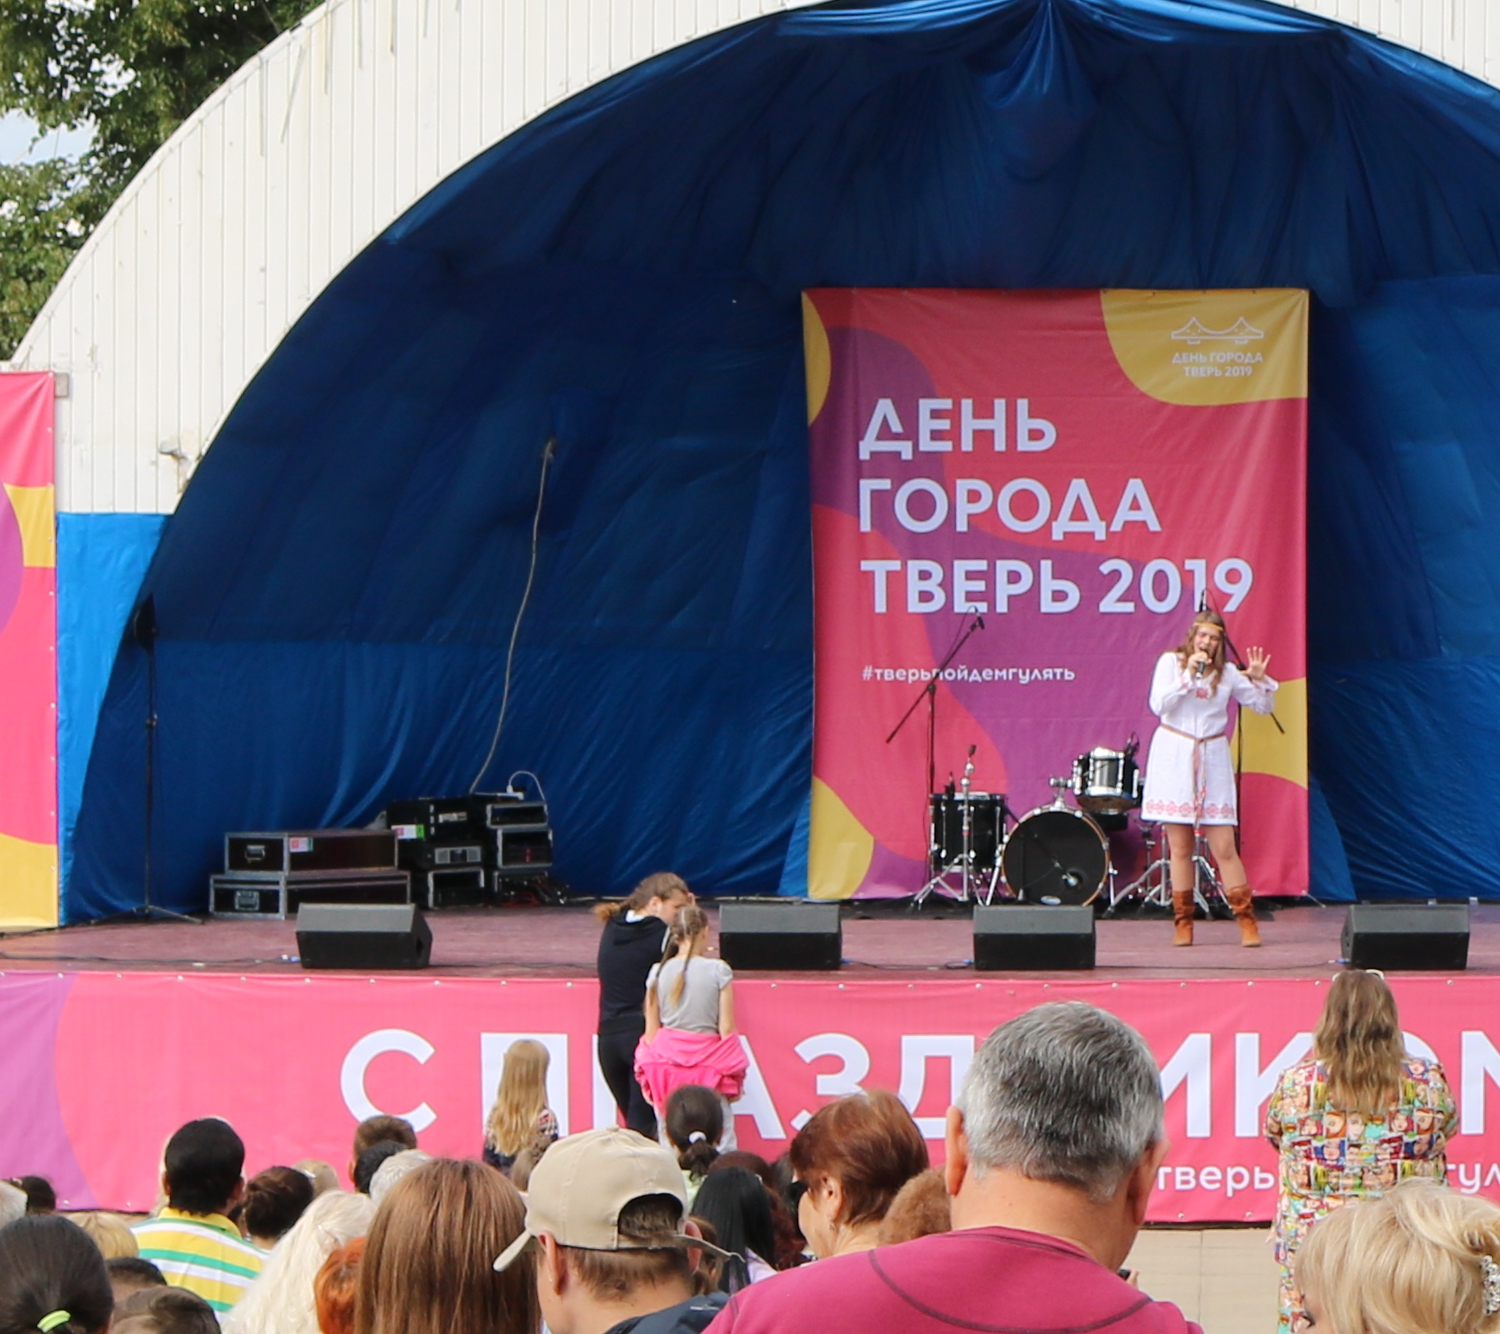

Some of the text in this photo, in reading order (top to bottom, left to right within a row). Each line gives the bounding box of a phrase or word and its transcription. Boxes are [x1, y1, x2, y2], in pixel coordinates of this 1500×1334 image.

[1171, 352, 1264, 365] ДЕНЬ ГОРОДА
[1183, 365, 1253, 377] ТВЕРЬ 2019
[858, 398, 1057, 461] ДЕНЬ
[859, 477, 1162, 541] ГОРОДА
[860, 557, 1253, 613] ТВЕРЬ 2019
[340, 1028, 437, 1133] С
